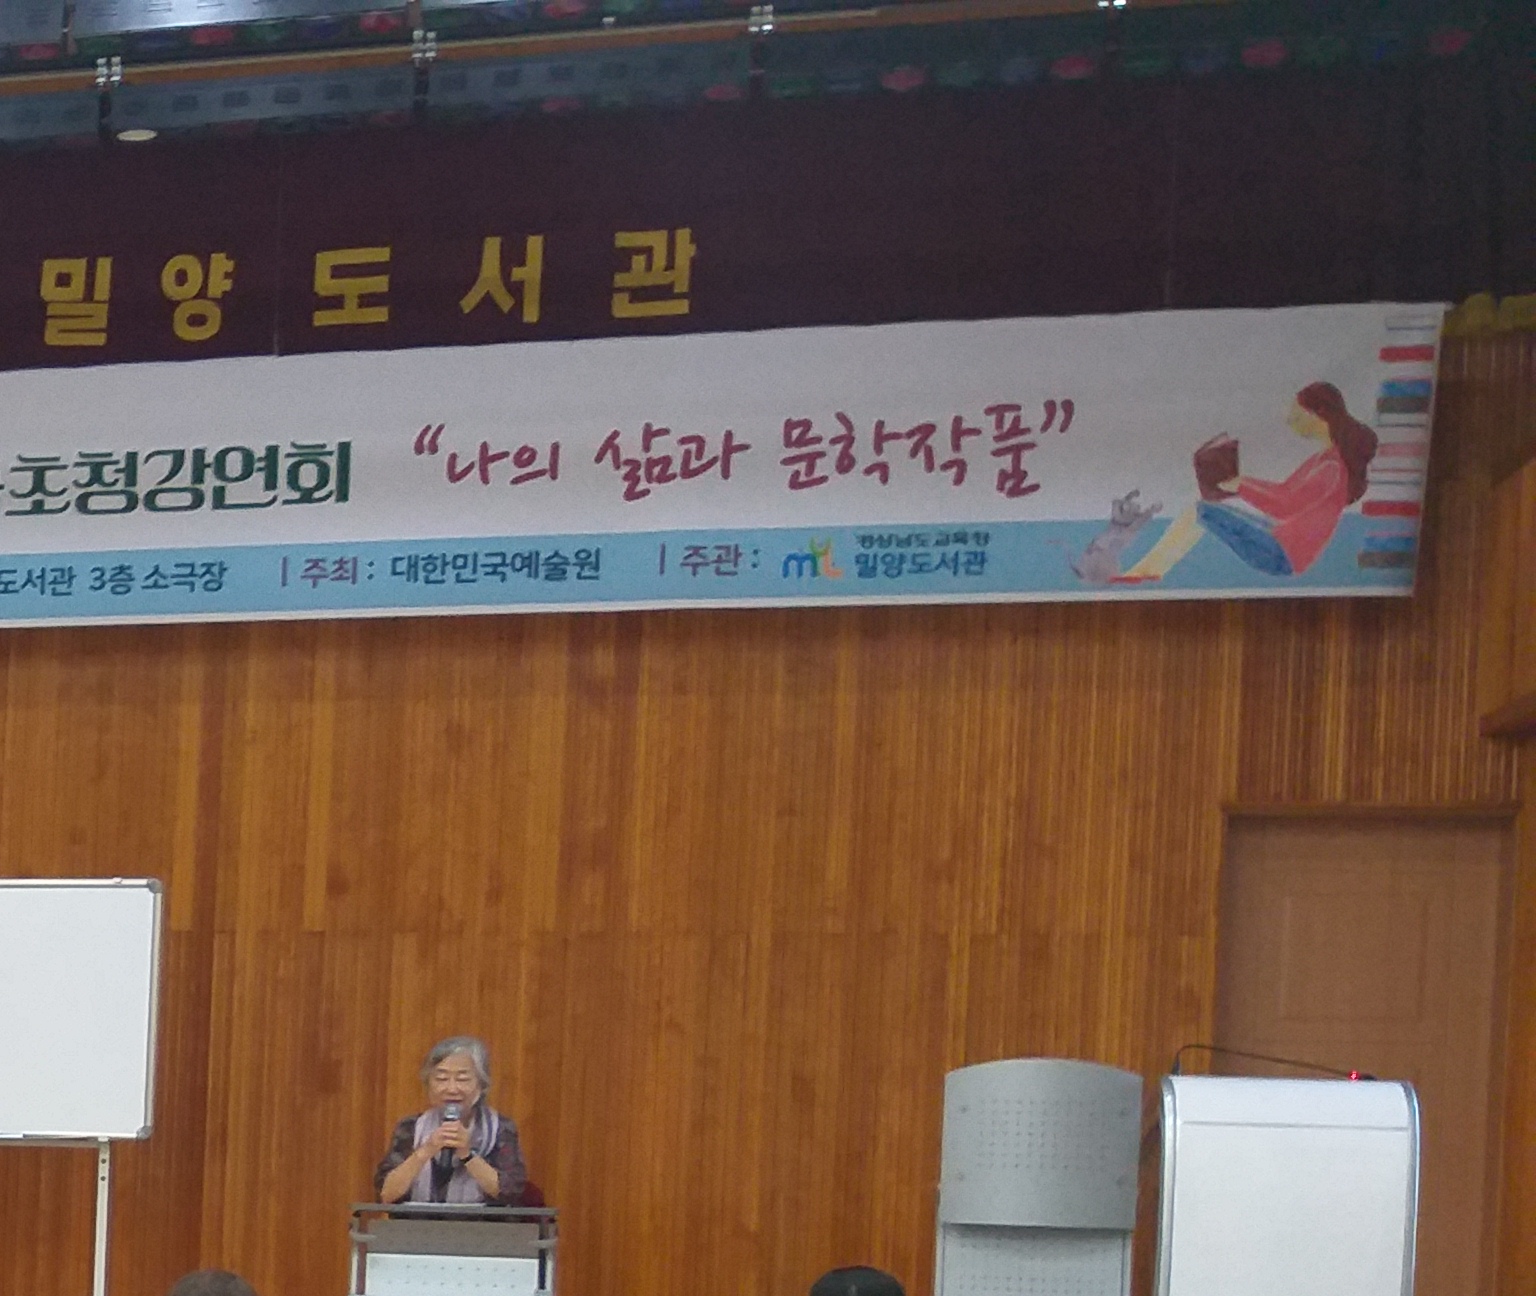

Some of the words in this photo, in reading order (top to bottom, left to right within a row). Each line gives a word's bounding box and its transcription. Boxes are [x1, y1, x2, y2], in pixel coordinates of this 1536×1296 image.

[413, 422, 562, 486] “나의
[593, 421, 753, 502] 삶과
[779, 398, 1076, 499] 문학작품”
[89, 564, 135, 595] 3층
[140, 559, 229, 594] 소극장
[389, 546, 602, 585] 대한민국예술원
[854, 549, 989, 579] 밀양도서관
